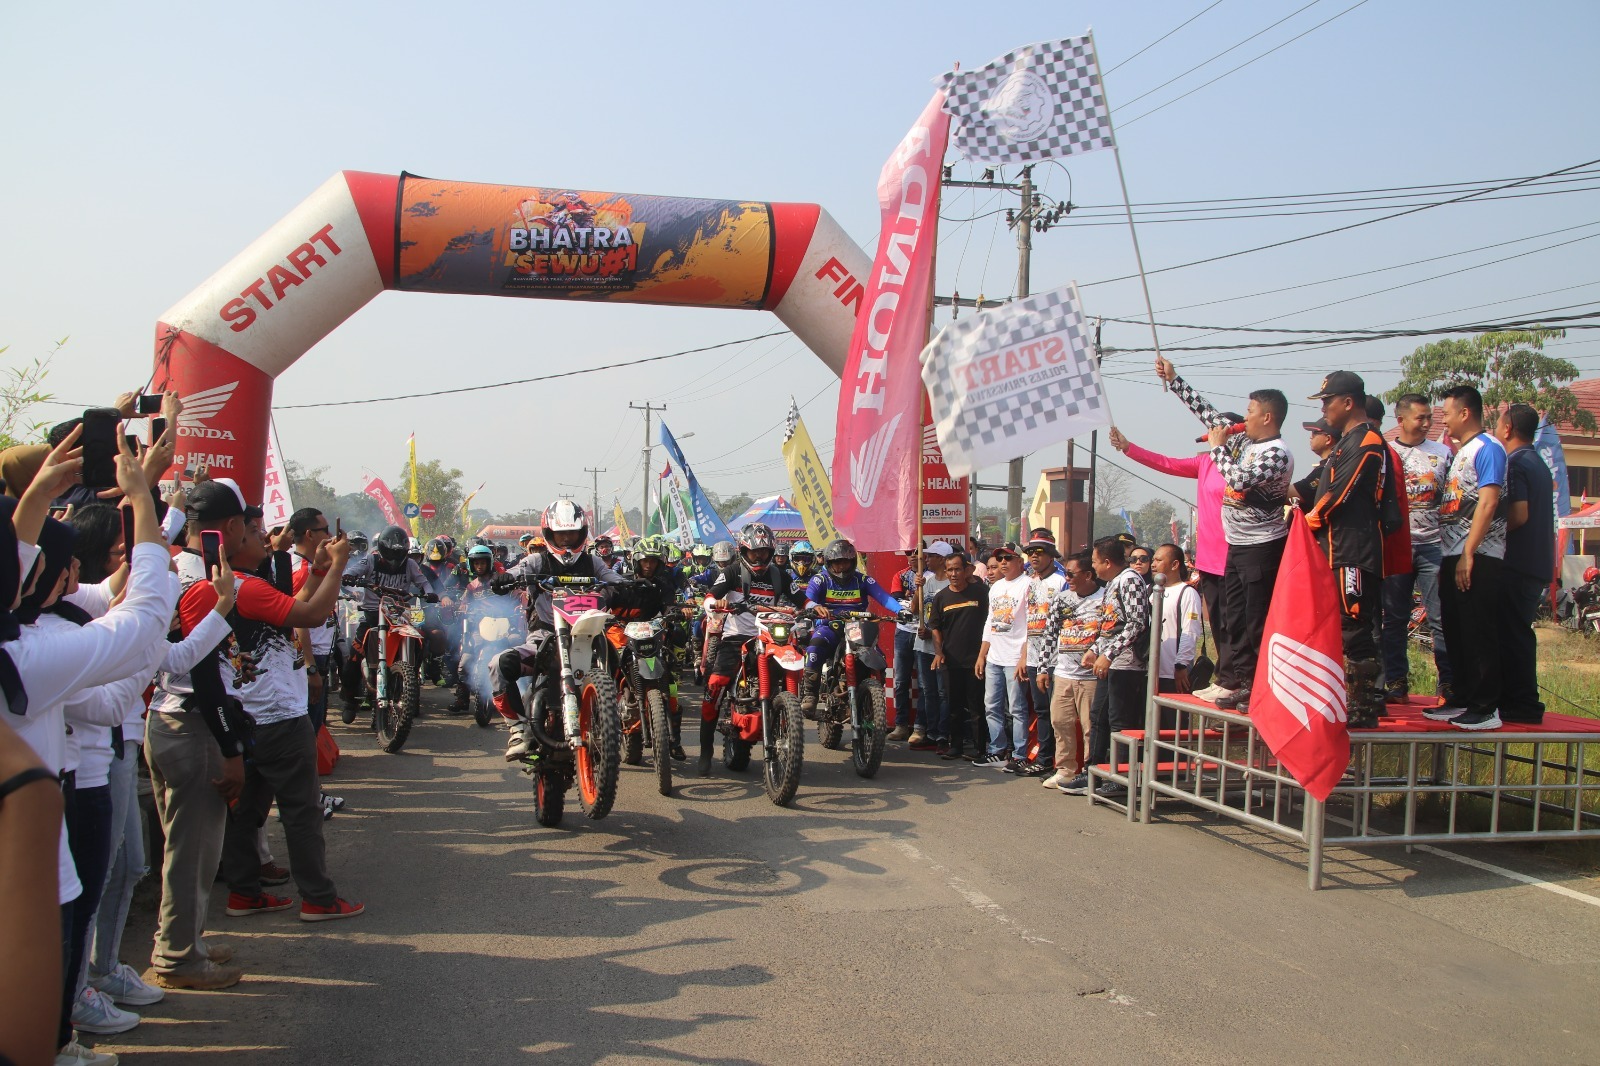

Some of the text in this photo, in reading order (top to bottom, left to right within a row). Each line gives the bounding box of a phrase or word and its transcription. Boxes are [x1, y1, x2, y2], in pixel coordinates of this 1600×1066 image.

[510, 226, 634, 250] BHATRA
[219, 223, 342, 332] START
[814, 256, 867, 318] FIN
[176, 426, 237, 441] ONDA
[187, 452, 234, 469] HEART.
[941, 508, 962, 516] Honda
[563, 595, 598, 612] 29
